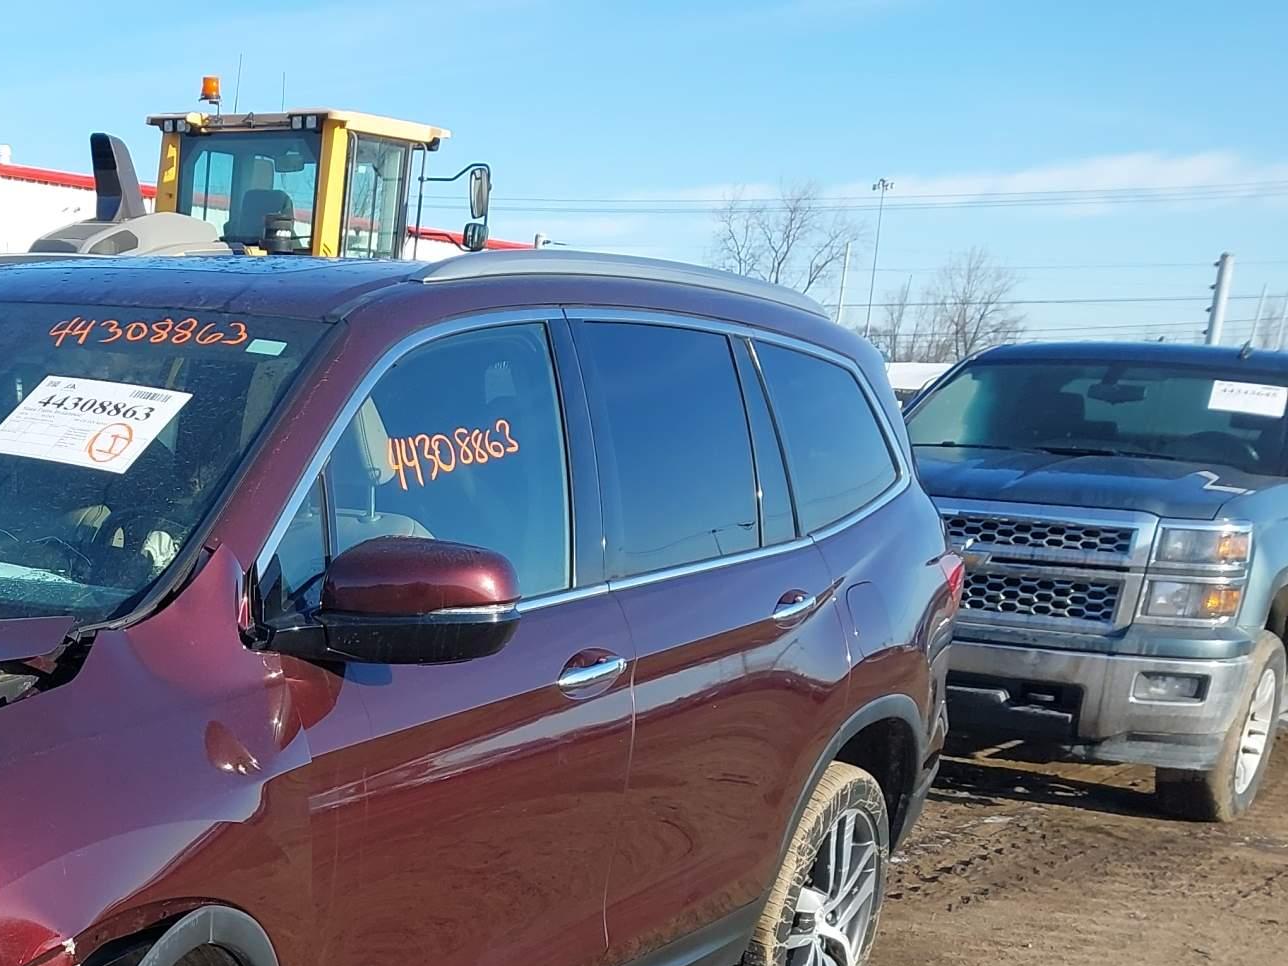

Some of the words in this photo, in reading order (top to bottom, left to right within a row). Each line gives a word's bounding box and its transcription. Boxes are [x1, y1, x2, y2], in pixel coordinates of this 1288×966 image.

[49, 316, 248, 347] 44308863
[38, 394, 156, 422] 44308863
[388, 419, 519, 491] 44308863
